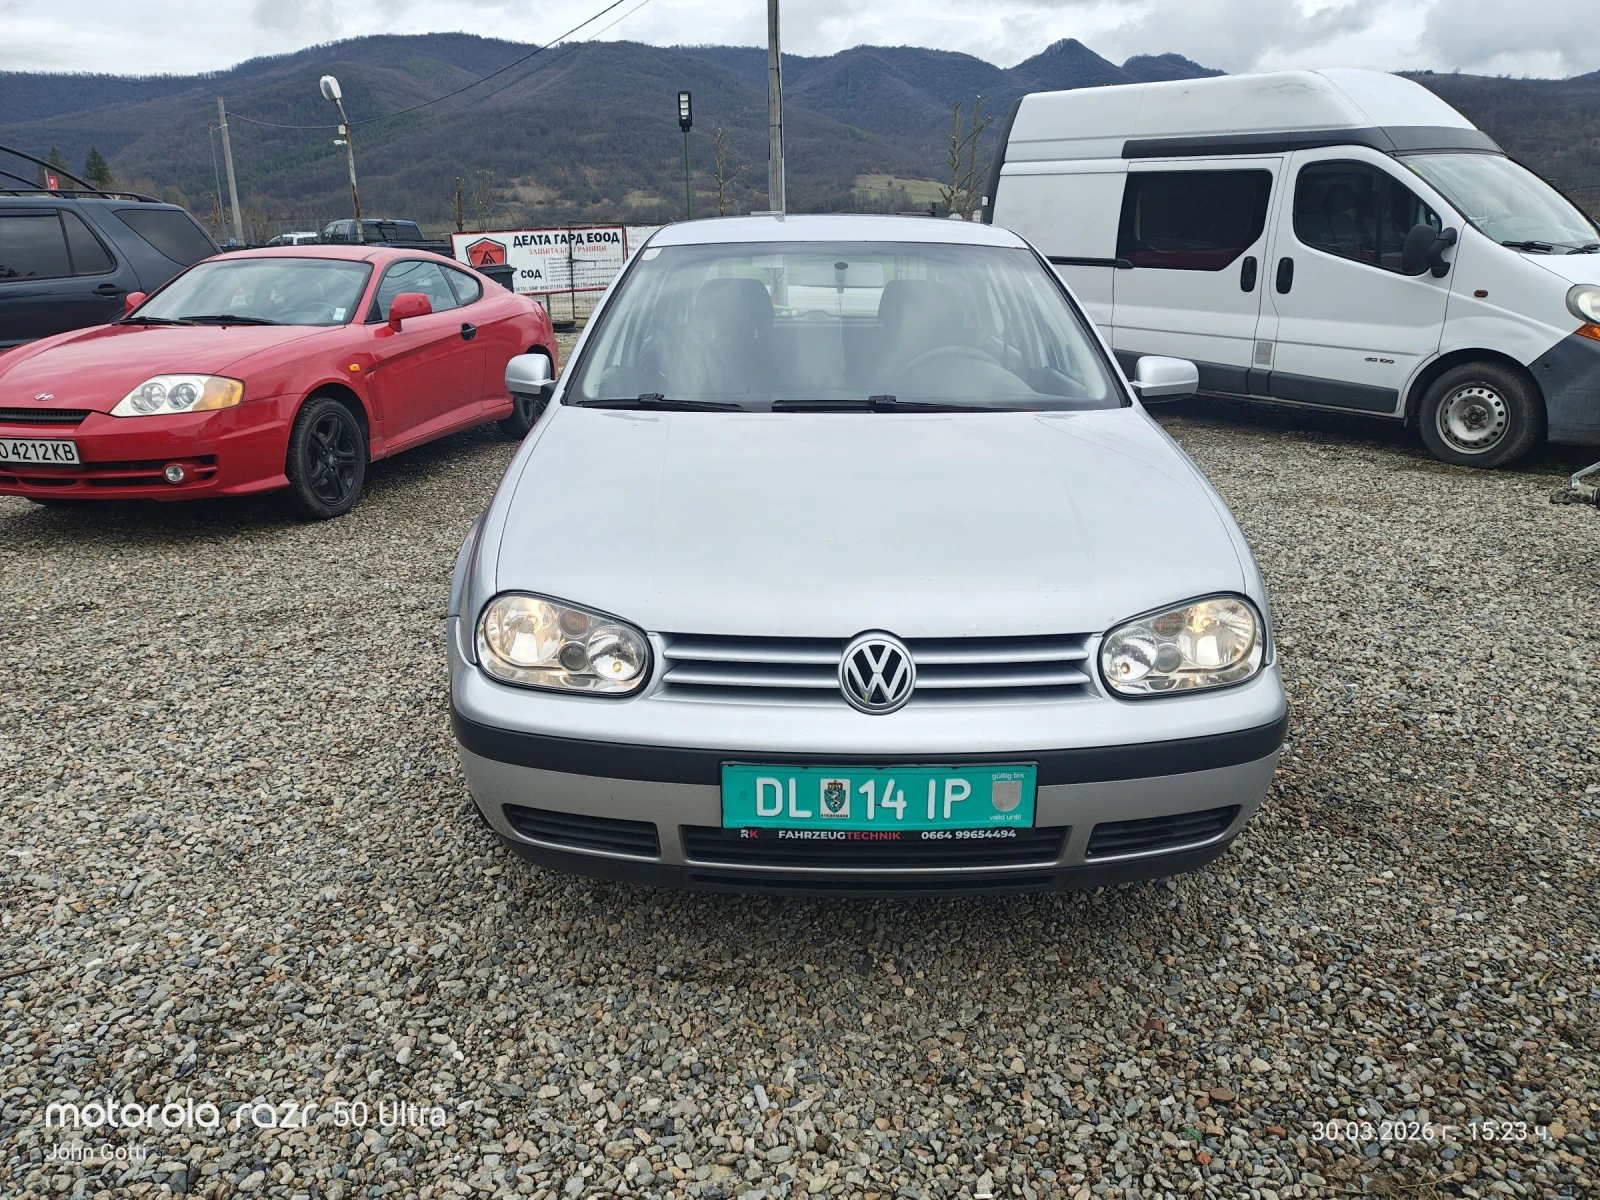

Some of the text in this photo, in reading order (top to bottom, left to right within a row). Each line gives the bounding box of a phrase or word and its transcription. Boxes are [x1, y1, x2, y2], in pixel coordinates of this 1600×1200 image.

[513, 232, 620, 248] ДЕЛТА ГАРД ЕООД
[560, 246, 573, 254] БЕ
[520, 269, 543, 279] СОД
[991, 771, 1025, 780] gültig bis
[756, 777, 972, 820] DL 14 IP
[1006, 813, 1022, 821] until
[740, 829, 1017, 840] RK FAHRZEUGTECHNIK 0664 99654494
